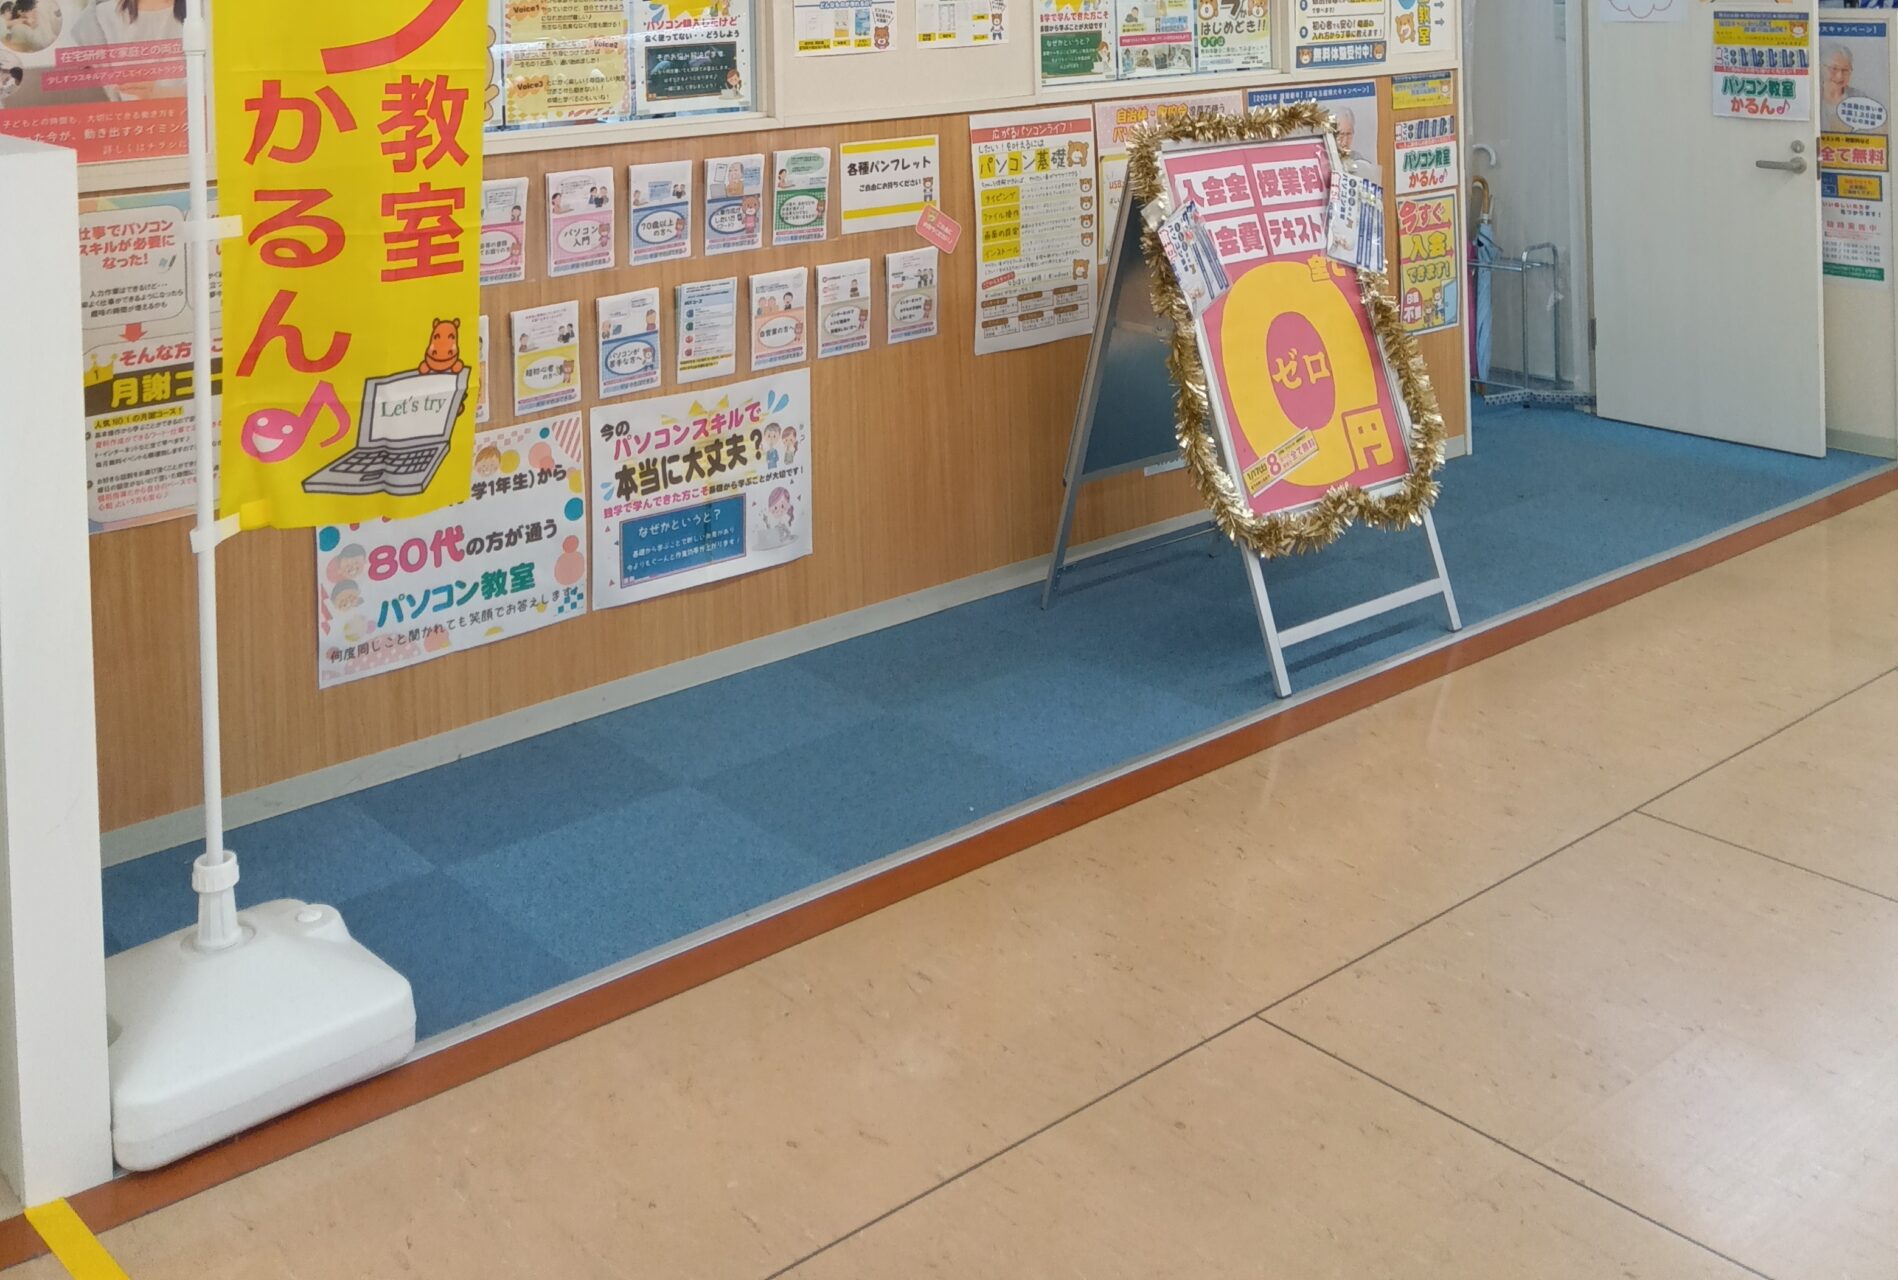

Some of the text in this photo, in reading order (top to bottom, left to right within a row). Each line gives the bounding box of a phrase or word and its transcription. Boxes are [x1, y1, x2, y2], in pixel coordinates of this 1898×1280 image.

[1721, 75, 1796, 100] パソコン教室
[847, 156, 932, 177] 各種パンフレット
[980, 147, 1067, 174] パソコン基礎
[1403, 146, 1452, 172] パソコン教室
[1821, 145, 1885, 165] 全て無料
[859, 178, 922, 194] ご自由にお持ちください
[1182, 164, 1325, 208] 入会金 授業料
[1400, 200, 1446, 233] 今すぐ
[1209, 214, 1325, 258] 会費 テキスト
[1408, 231, 1448, 263] 入会
[1271, 348, 1331, 391] ゼロ
[380, 393, 447, 418] Let's try
[600, 419, 630, 442] 今の
[614, 401, 762, 460] パソコンスキルで
[1342, 407, 1395, 471] 円
[1267, 453, 1282, 476] 8
[377, 561, 536, 628] パソコン教室
